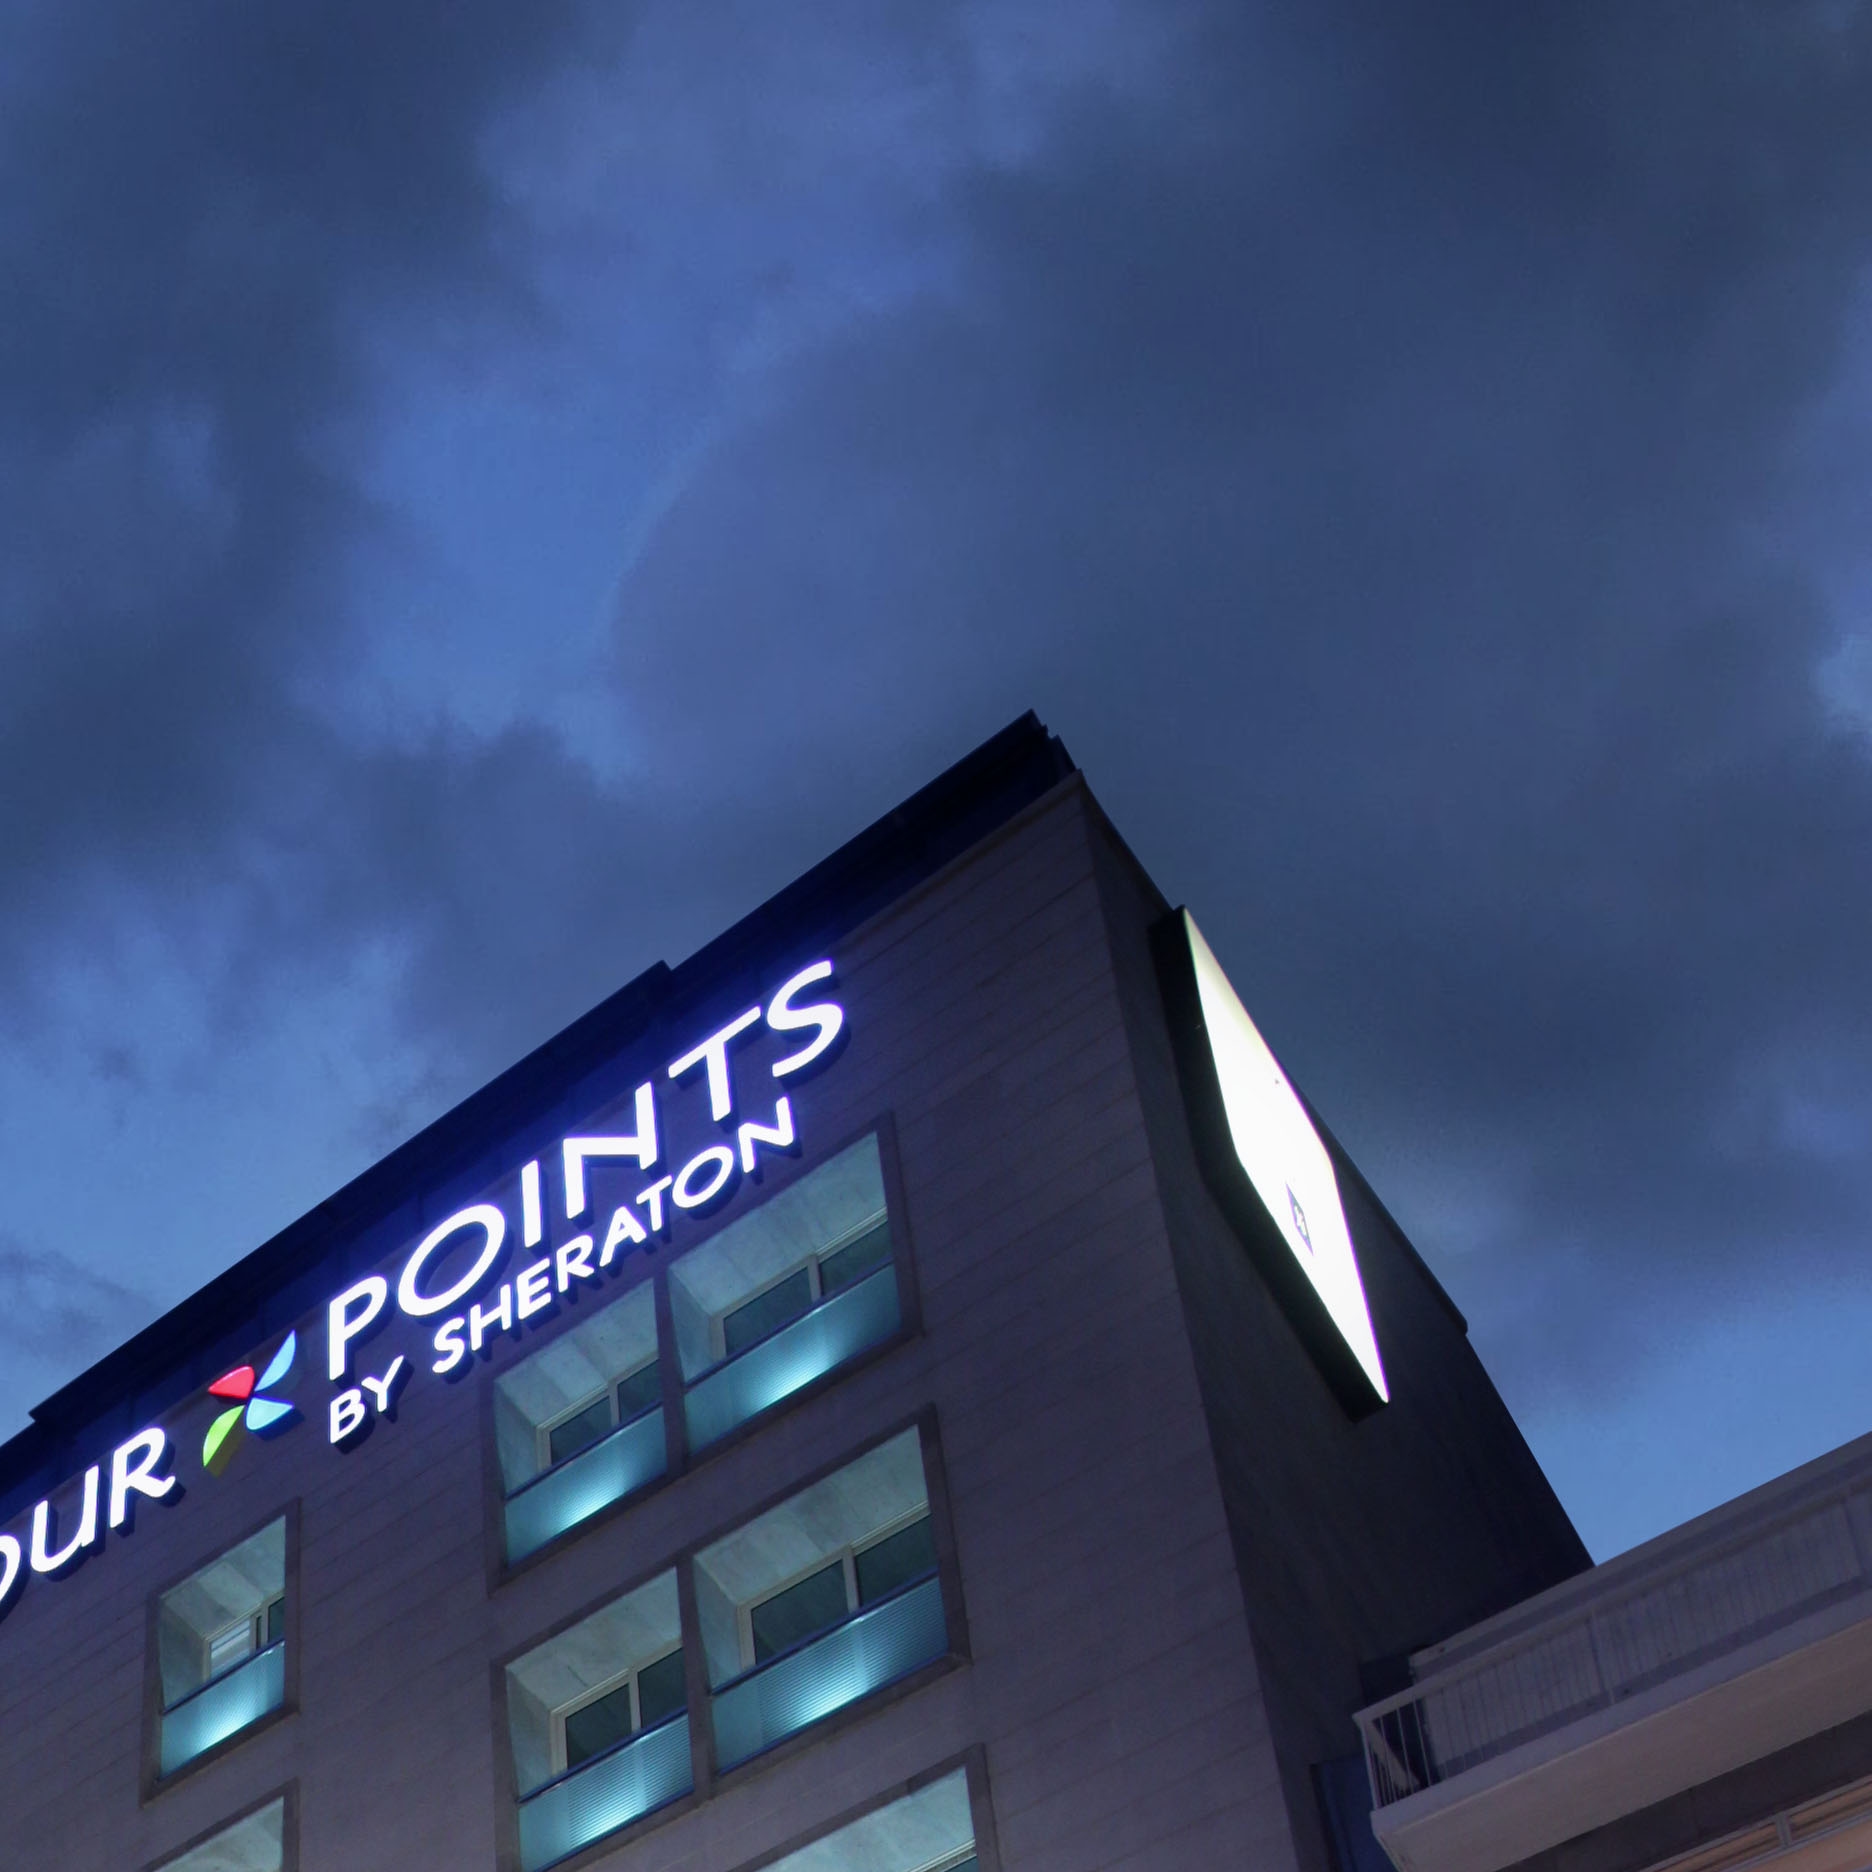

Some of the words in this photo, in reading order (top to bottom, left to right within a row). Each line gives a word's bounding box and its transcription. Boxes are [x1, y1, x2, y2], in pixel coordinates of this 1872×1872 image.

[328, 959, 845, 1382] POINTS
[329, 1354, 405, 1445] BY
[431, 1095, 795, 1375] SHERATON
